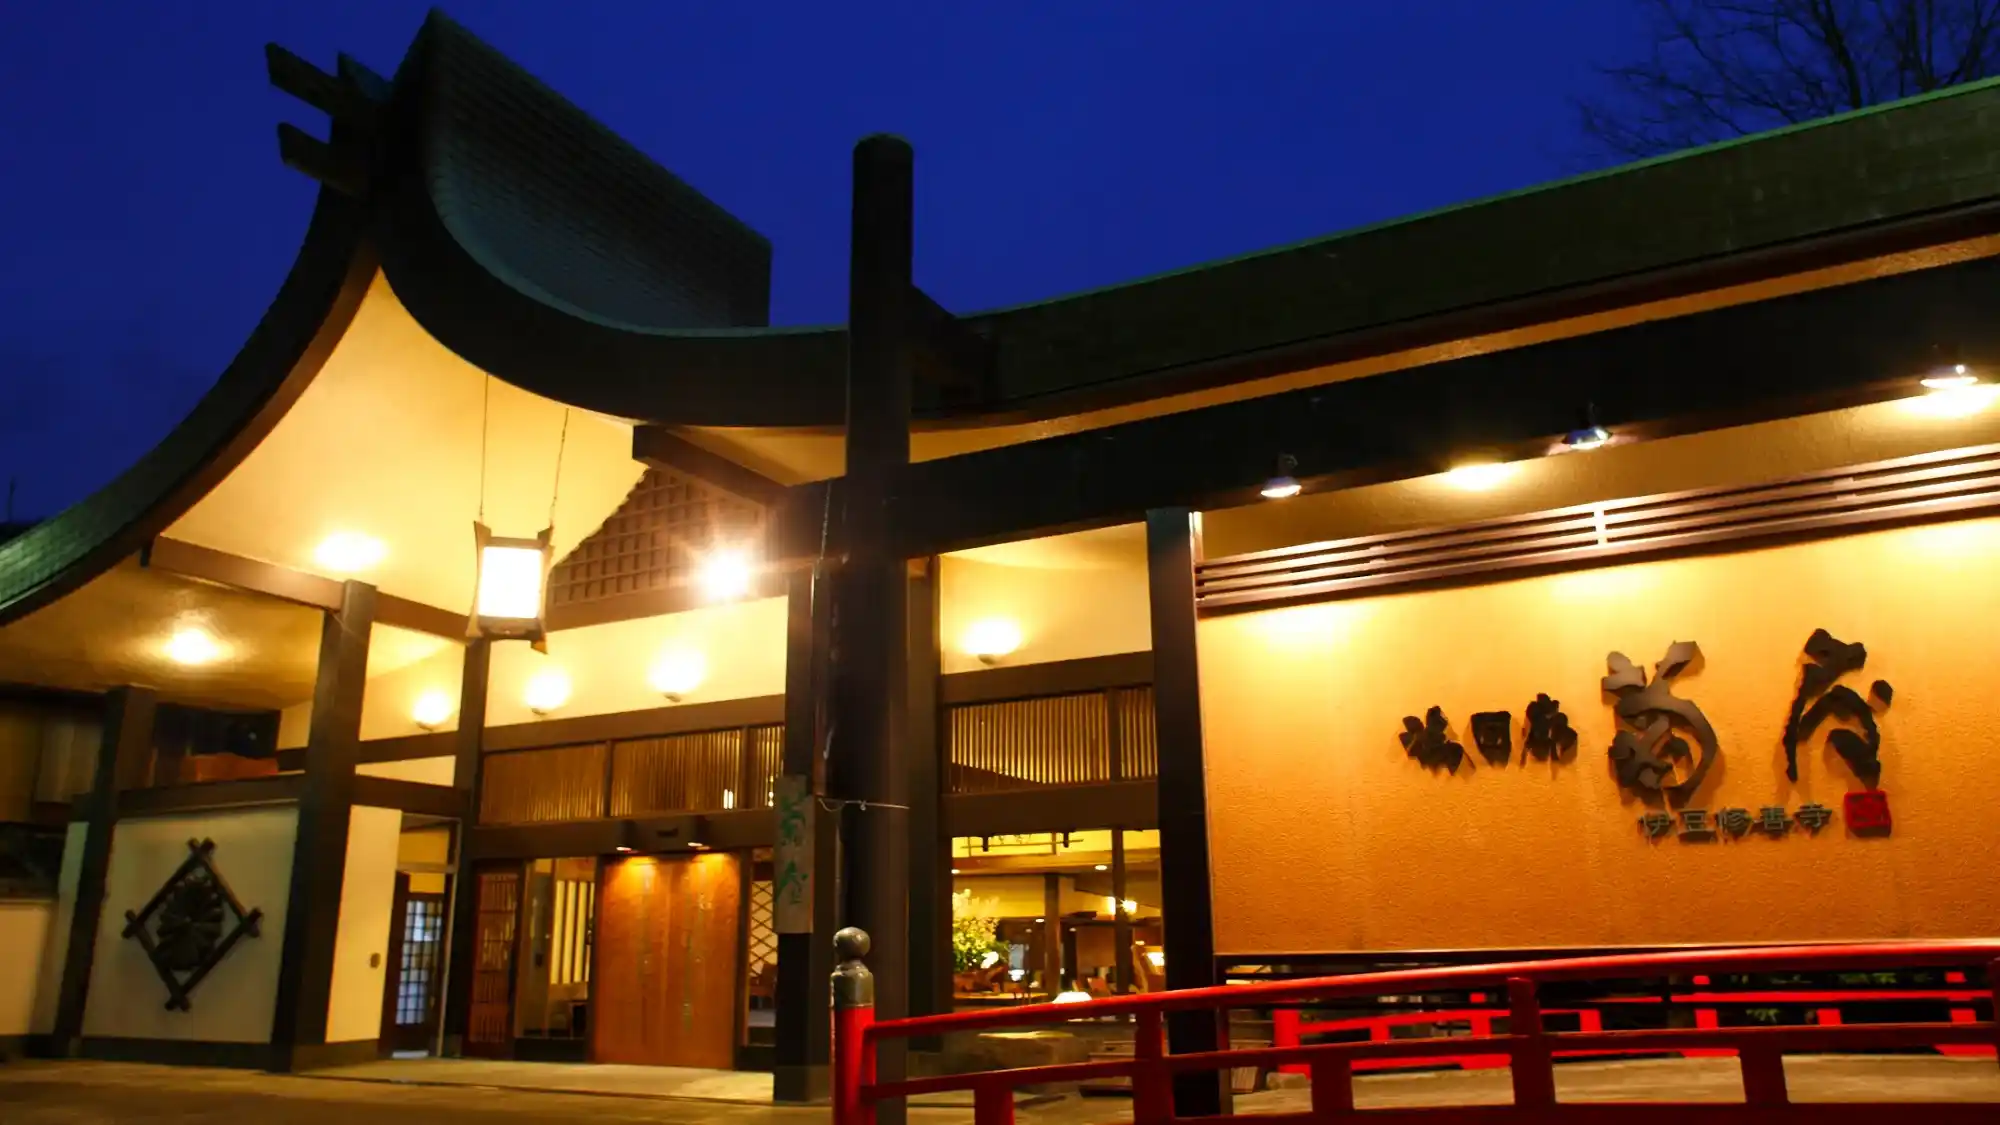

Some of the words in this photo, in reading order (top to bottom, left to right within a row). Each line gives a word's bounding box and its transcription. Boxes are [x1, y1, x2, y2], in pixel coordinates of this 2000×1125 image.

[1638, 803, 1832, 840] 伊豆修善寺
